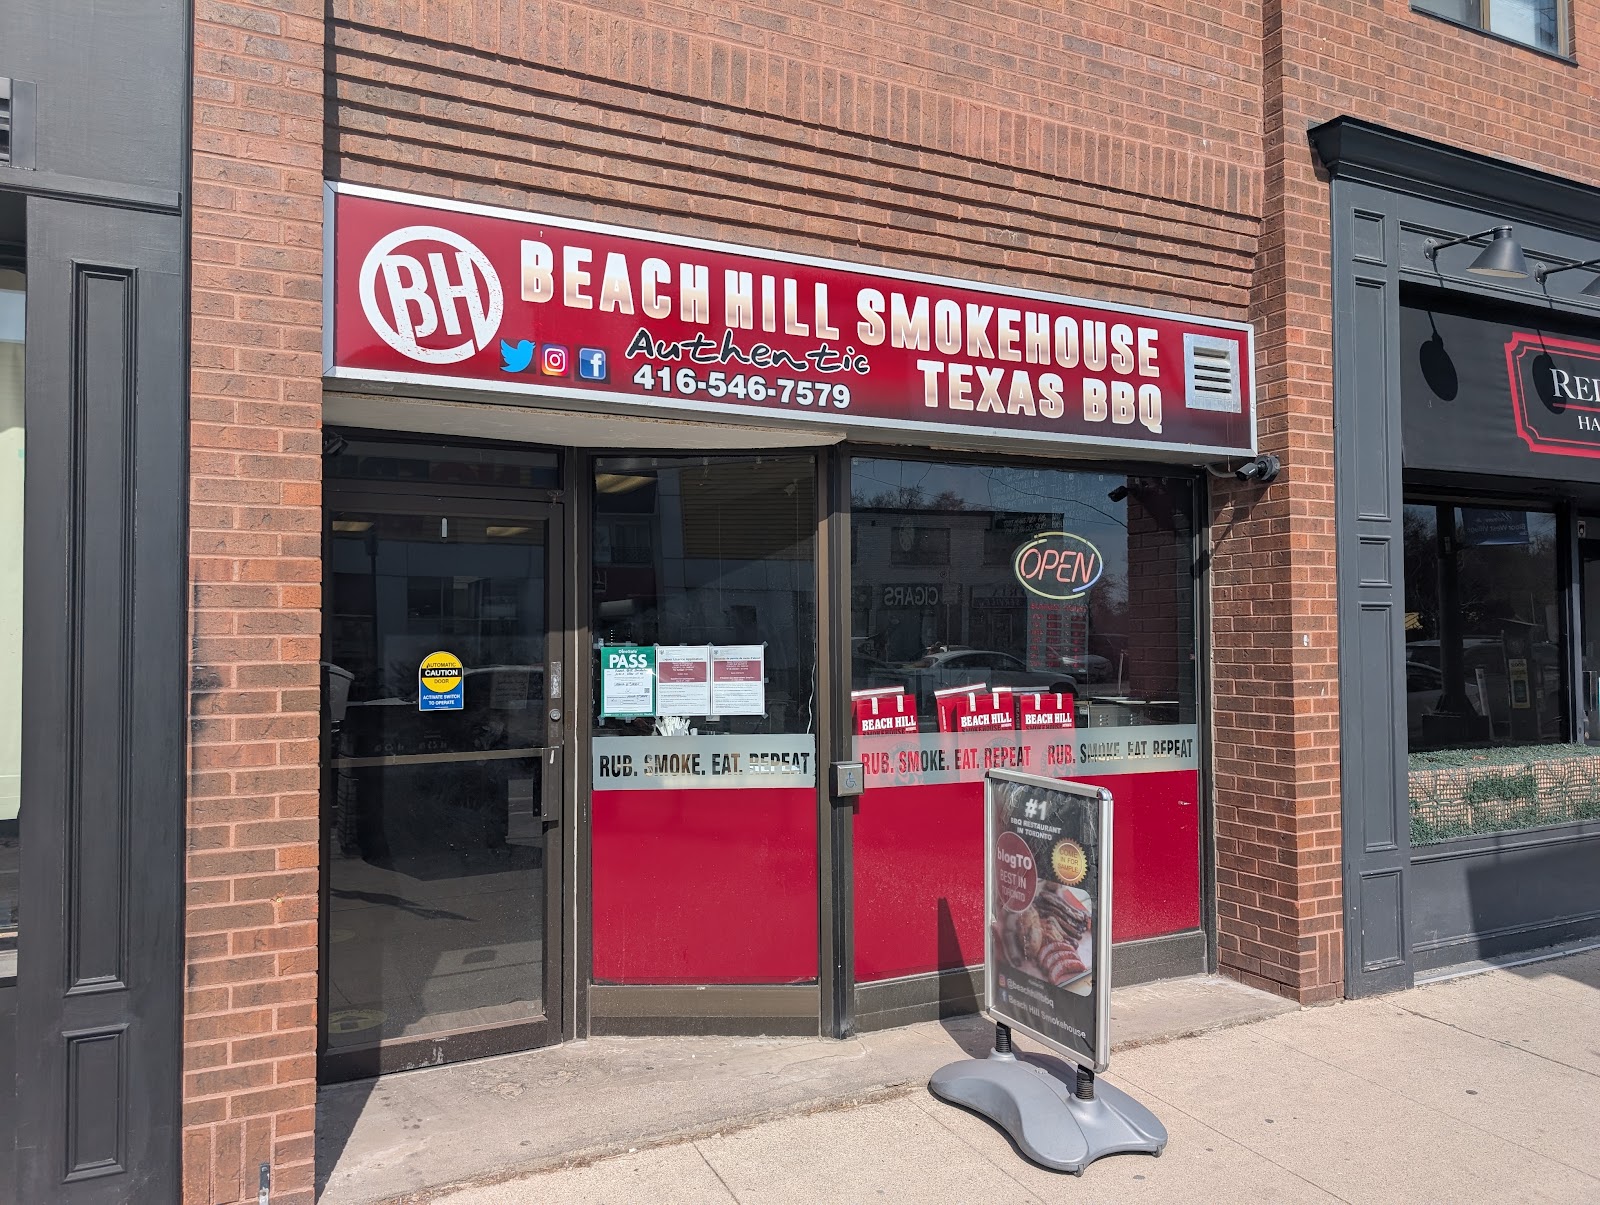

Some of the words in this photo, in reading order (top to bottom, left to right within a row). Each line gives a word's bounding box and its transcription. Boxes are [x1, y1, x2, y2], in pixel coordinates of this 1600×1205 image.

[520, 239, 709, 325] BEACH
[724, 269, 840, 341] HILL
[856, 288, 1161, 378] SMOKEHOUSE
[625, 327, 871, 377] Authentic
[633, 365, 851, 410] 416-546-7579
[917, 359, 1064, 419] TEXAS
[1083, 377, 1163, 434] BBQ
[1020, 548, 1095, 584] OPEN
[609, 654, 648, 669] PASS
[862, 717, 893, 732] BEACH
[895, 715, 917, 728] HILL
[961, 715, 990, 728] BEACH
[991, 712, 1012, 724] HILL
[1025, 713, 1053, 725] BEACH
[1054, 712, 1072, 723] HILL
[861, 752, 895, 775] RUB.
[899, 749, 950, 773] SMOKE.
[955, 748, 980, 769] EAT.
[984, 746, 1031, 769] REPEAT
[1048, 744, 1076, 765] RUB.
[1153, 739, 1193, 759] REPEAT
[599, 755, 637, 777] RUB.
[644, 753, 706, 776] SMOKE.
[711, 753, 743, 776] EAT.
[749, 753, 810, 775] REPEAT
[1024, 798, 1047, 820] #1
[1010, 816, 1022, 825] BBQ
[1023, 820, 1062, 834] RESTAURANT
[1025, 828, 1052, 841] TORONTO
[997, 847, 1032, 870] blogTO
[1059, 848, 1078, 858] COME
[1067, 857, 1078, 866] FOR
[1057, 862, 1078, 873] SAMPLE
[1000, 869, 1017, 885] BEST
[1018, 876, 1027, 890] IN
[1001, 885, 1026, 902] TORONTO
[1008, 994, 1028, 1011] Beach
[1028, 1004, 1040, 1017] Hill
[1040, 1010, 1086, 1039] Smokehouse
